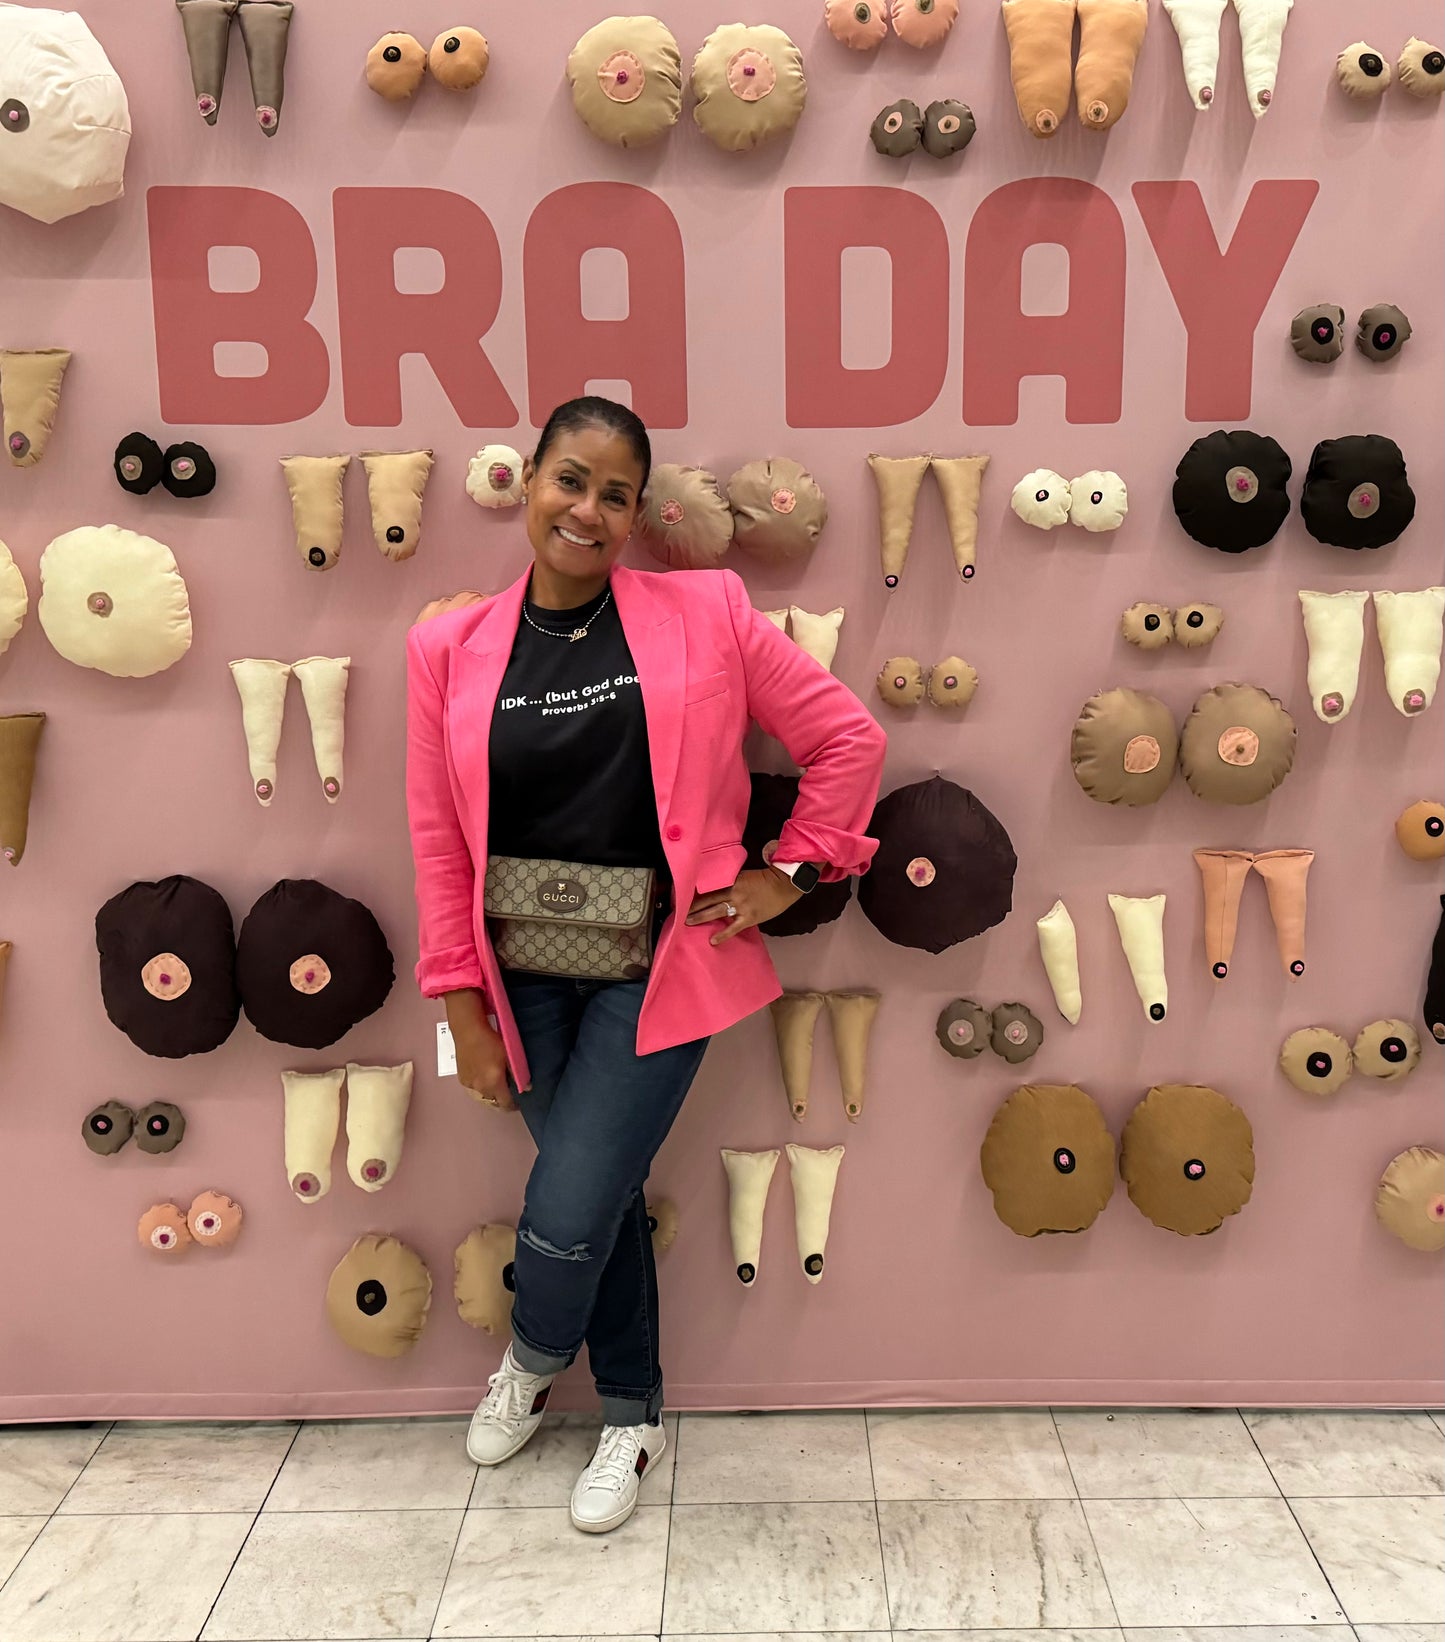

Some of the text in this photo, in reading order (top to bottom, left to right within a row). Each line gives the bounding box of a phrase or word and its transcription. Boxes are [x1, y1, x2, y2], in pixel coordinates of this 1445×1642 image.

[147, 176, 1320, 429] BRA DAY
[501, 695, 527, 710] IDK
[545, 689, 578, 704] (but
[581, 678, 610, 697] God
[542, 702, 588, 716] Proverbs
[542, 892, 579, 904] GUCCI
